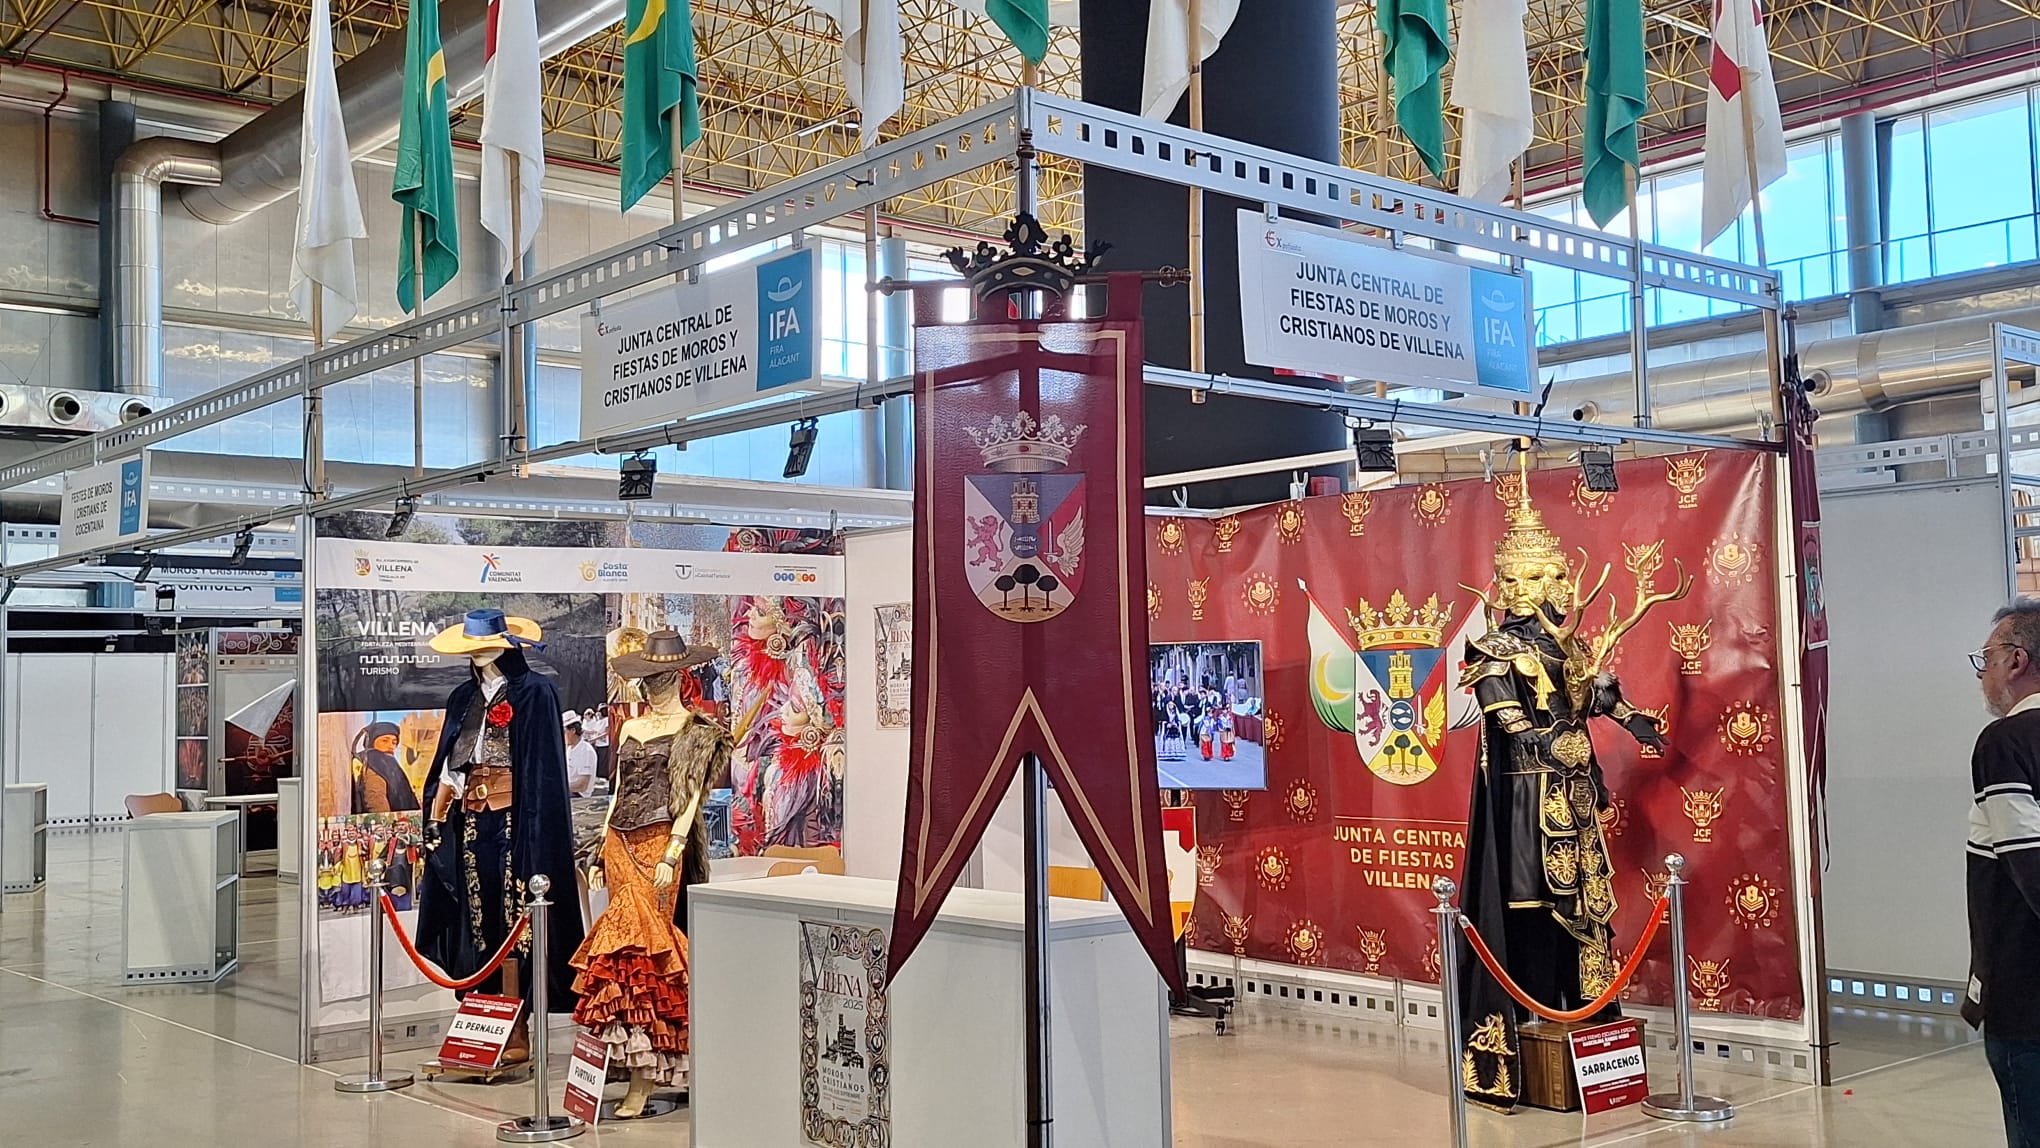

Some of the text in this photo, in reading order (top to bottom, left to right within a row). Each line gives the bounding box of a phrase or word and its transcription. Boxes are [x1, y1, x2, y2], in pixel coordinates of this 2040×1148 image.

[1296, 261, 1443, 305] JUNTA CENTRAL DE
[1290, 288, 1451, 332] FIESTAS DE MOROS Y
[617, 304, 733, 355] JUNTA CENTRAL DE
[769, 306, 801, 342] IFA
[1484, 317, 1516, 347] IFA
[1280, 315, 1465, 361] CRISTIANOS DE VILLENA
[613, 329, 739, 382] FIESTAS DE MOROS Y
[769, 345, 784, 356] FIRA
[769, 352, 801, 369] ALACANT
[604, 355, 748, 408] CRISTIANOS DE VILLENA
[71, 488, 87, 503] FESTES
[87, 486, 94, 499] DE
[94, 481, 113, 497] MOROS
[124, 489, 137, 508] IFA
[1678, 494, 1698, 504] JCF
[76, 502, 100, 519] CRISTIANS
[100, 500, 108, 513] DE
[75, 519, 104, 536] COCENTAINA
[1350, 524, 1365, 533] JCF
[1218, 541, 1232, 549] JCF
[376, 564, 413, 572] VILLENA
[598, 569, 628, 577] Blanca
[603, 562, 628, 570] Costa
[357, 620, 438, 636] VILLENA
[360, 667, 400, 675] TURISMO
[1681, 661, 1702, 670] JCF
[1230, 810, 1244, 818] JCF
[1333, 825, 1466, 849] JUNTA CENTRA
[1694, 828, 1712, 838] JCF
[1350, 848, 1454, 869] DE FIESTAS
[1199, 875, 1215, 884] JCF
[1365, 962, 1380, 971] JCF
[842, 998, 864, 1011] 2025
[1700, 998, 1721, 1007] JCF
[454, 1020, 506, 1036] EL PERNALES
[822, 1066, 844, 1079] MOROS
[1581, 1054, 1640, 1076] SARRACENOS
[574, 1066, 597, 1086] FURTIVAS
[822, 1075, 865, 1093] CRISTIANOS
